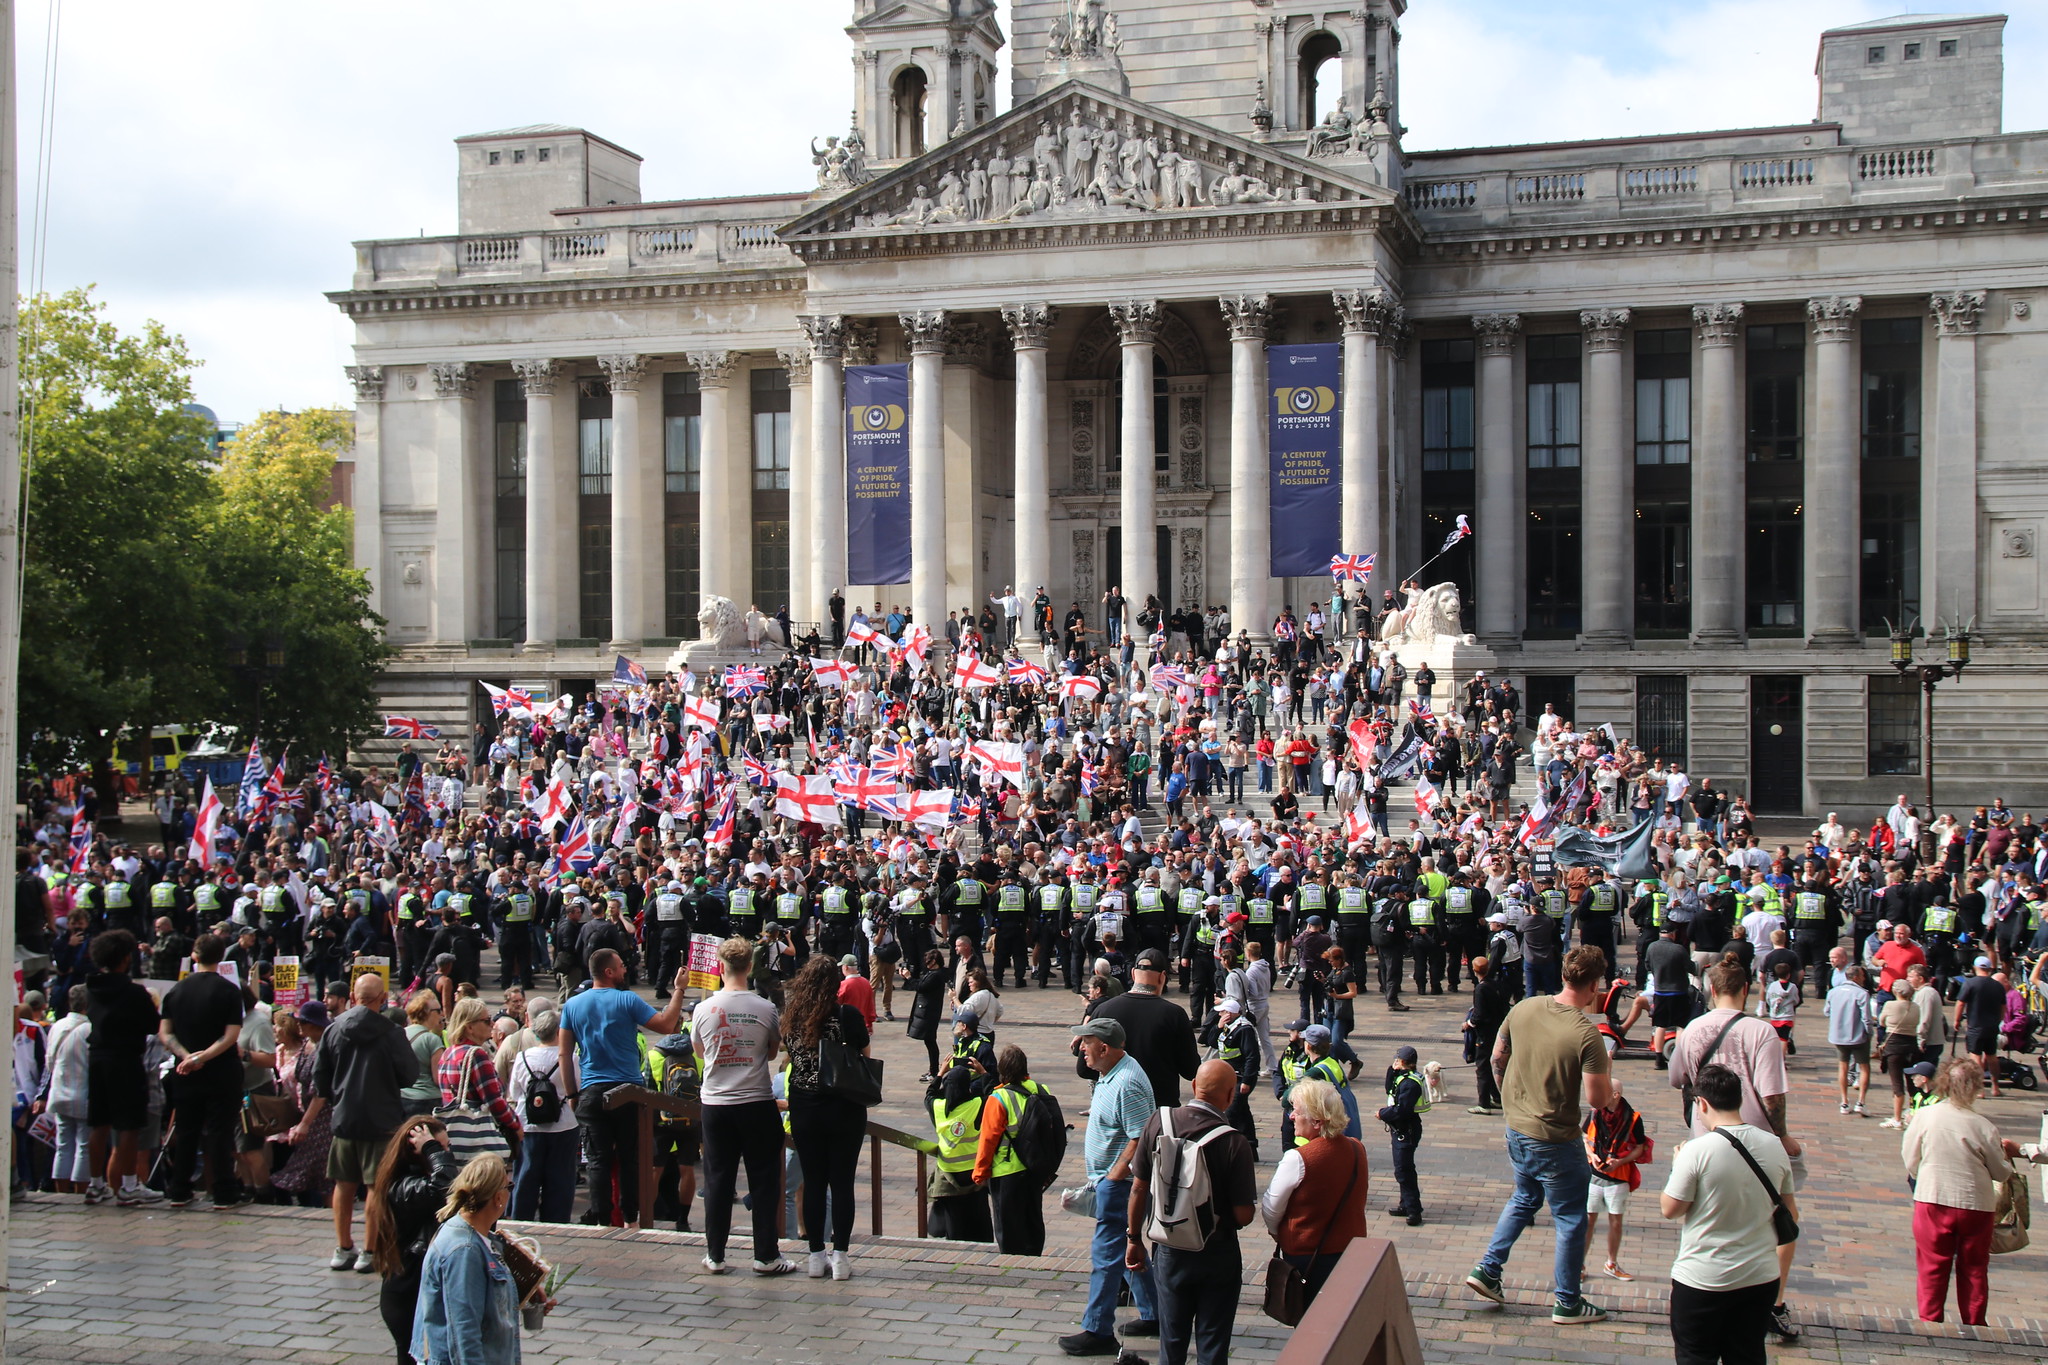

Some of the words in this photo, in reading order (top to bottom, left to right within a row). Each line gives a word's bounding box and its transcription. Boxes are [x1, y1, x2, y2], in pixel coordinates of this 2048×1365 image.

[1273, 385, 1335, 415] 100
[849, 403, 905, 431] 100
[1277, 415, 1330, 424] PORTSMOUTH
[853, 432, 901, 440] PORTSMOUTH
[1290, 451, 1327, 459] CENTURY
[1298, 460, 1324, 468] PRIDE,
[1287, 469, 1317, 477] FUTURE
[1319, 468, 1331, 476] OF
[1280, 477, 1329, 486] POSSIBILITY
[856, 491, 900, 499] POSSIBILITY
[1532, 844, 1553, 852] #SAVE
[1536, 854, 1550, 862] OUR
[1535, 863, 1551, 872] KIDS
[692, 943, 718, 953] WOMEN
[691, 957, 706, 965] THE
[706, 959, 718, 968] FAR
[691, 964, 713, 973] RIGHT
[276, 973, 296, 981] LIVES
